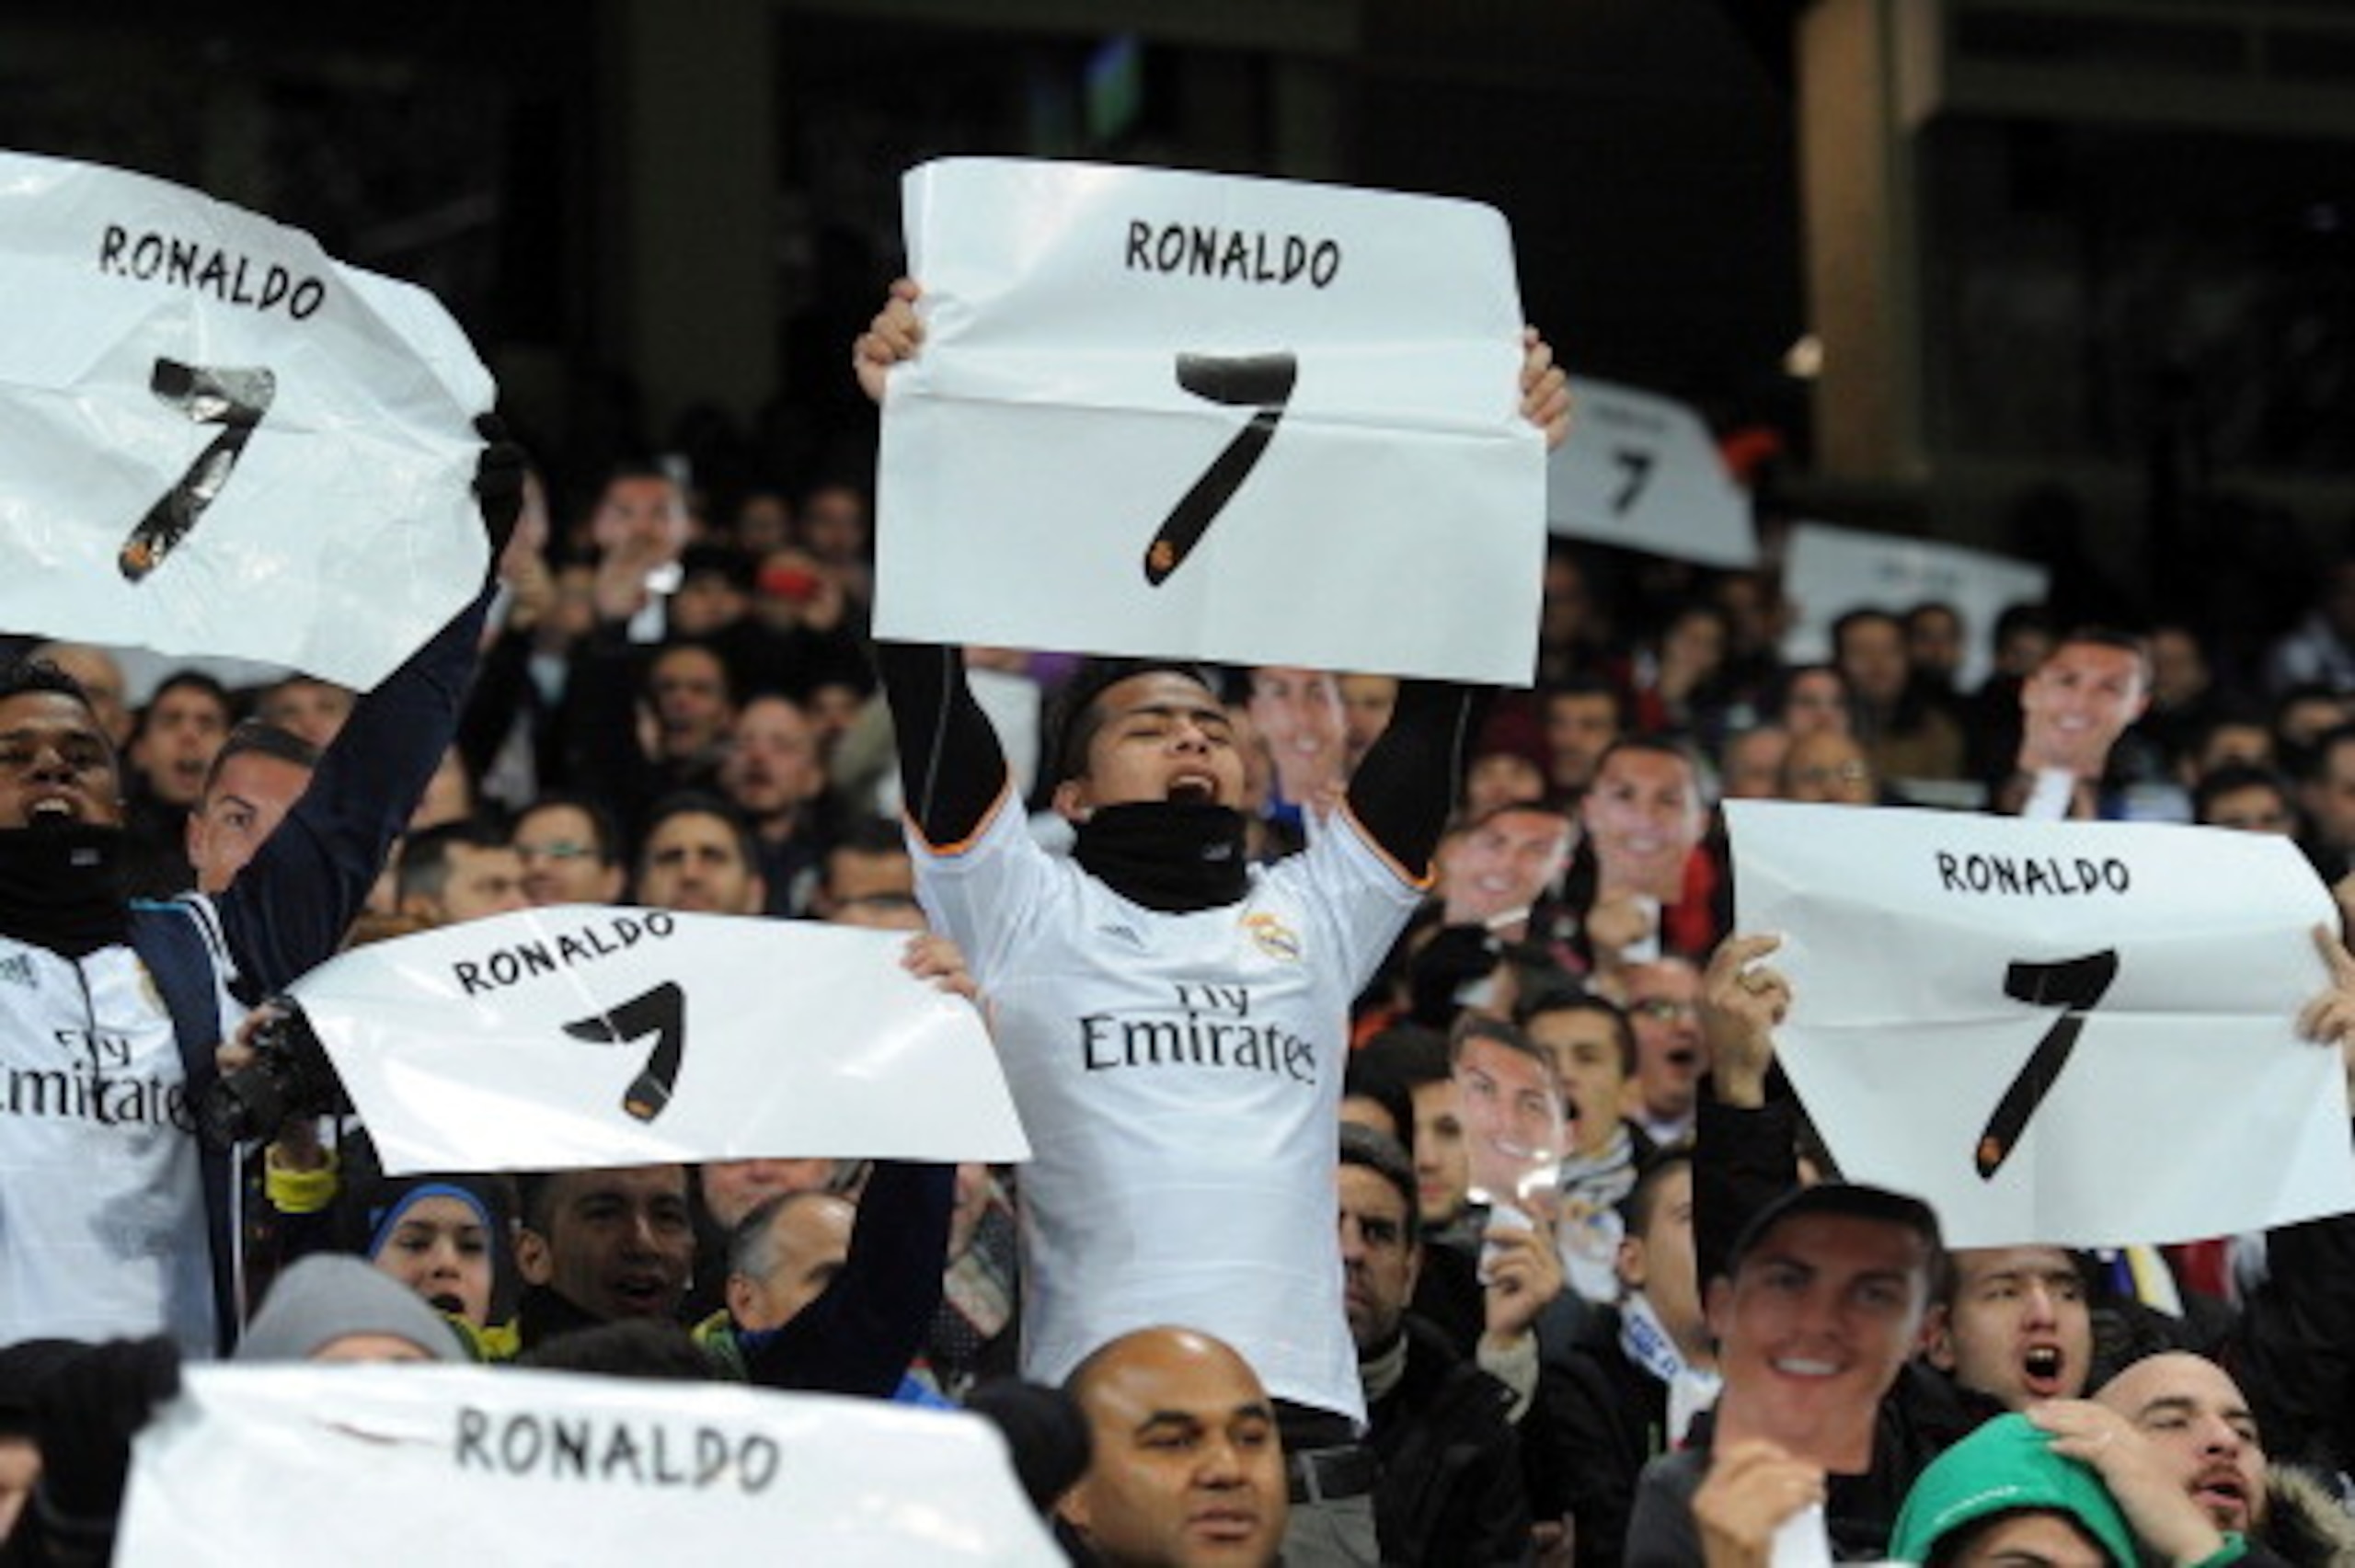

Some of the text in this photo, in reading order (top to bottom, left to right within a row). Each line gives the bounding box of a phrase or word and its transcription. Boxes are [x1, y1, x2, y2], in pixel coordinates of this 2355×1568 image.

[98, 223, 326, 322] RONALDO
[1125, 220, 1341, 290] RONALDO
[117, 355, 277, 586] 7
[1143, 352, 1299, 588] 7
[1614, 451, 1655, 512] 7
[1936, 851, 2131, 897] RONALDO
[453, 911, 675, 996] RONALDO
[0, 1059, 197, 1134] mirate
[560, 979, 688, 1125] 7
[1973, 946, 2120, 1183] 7
[453, 1406, 782, 1495] RONALDO
